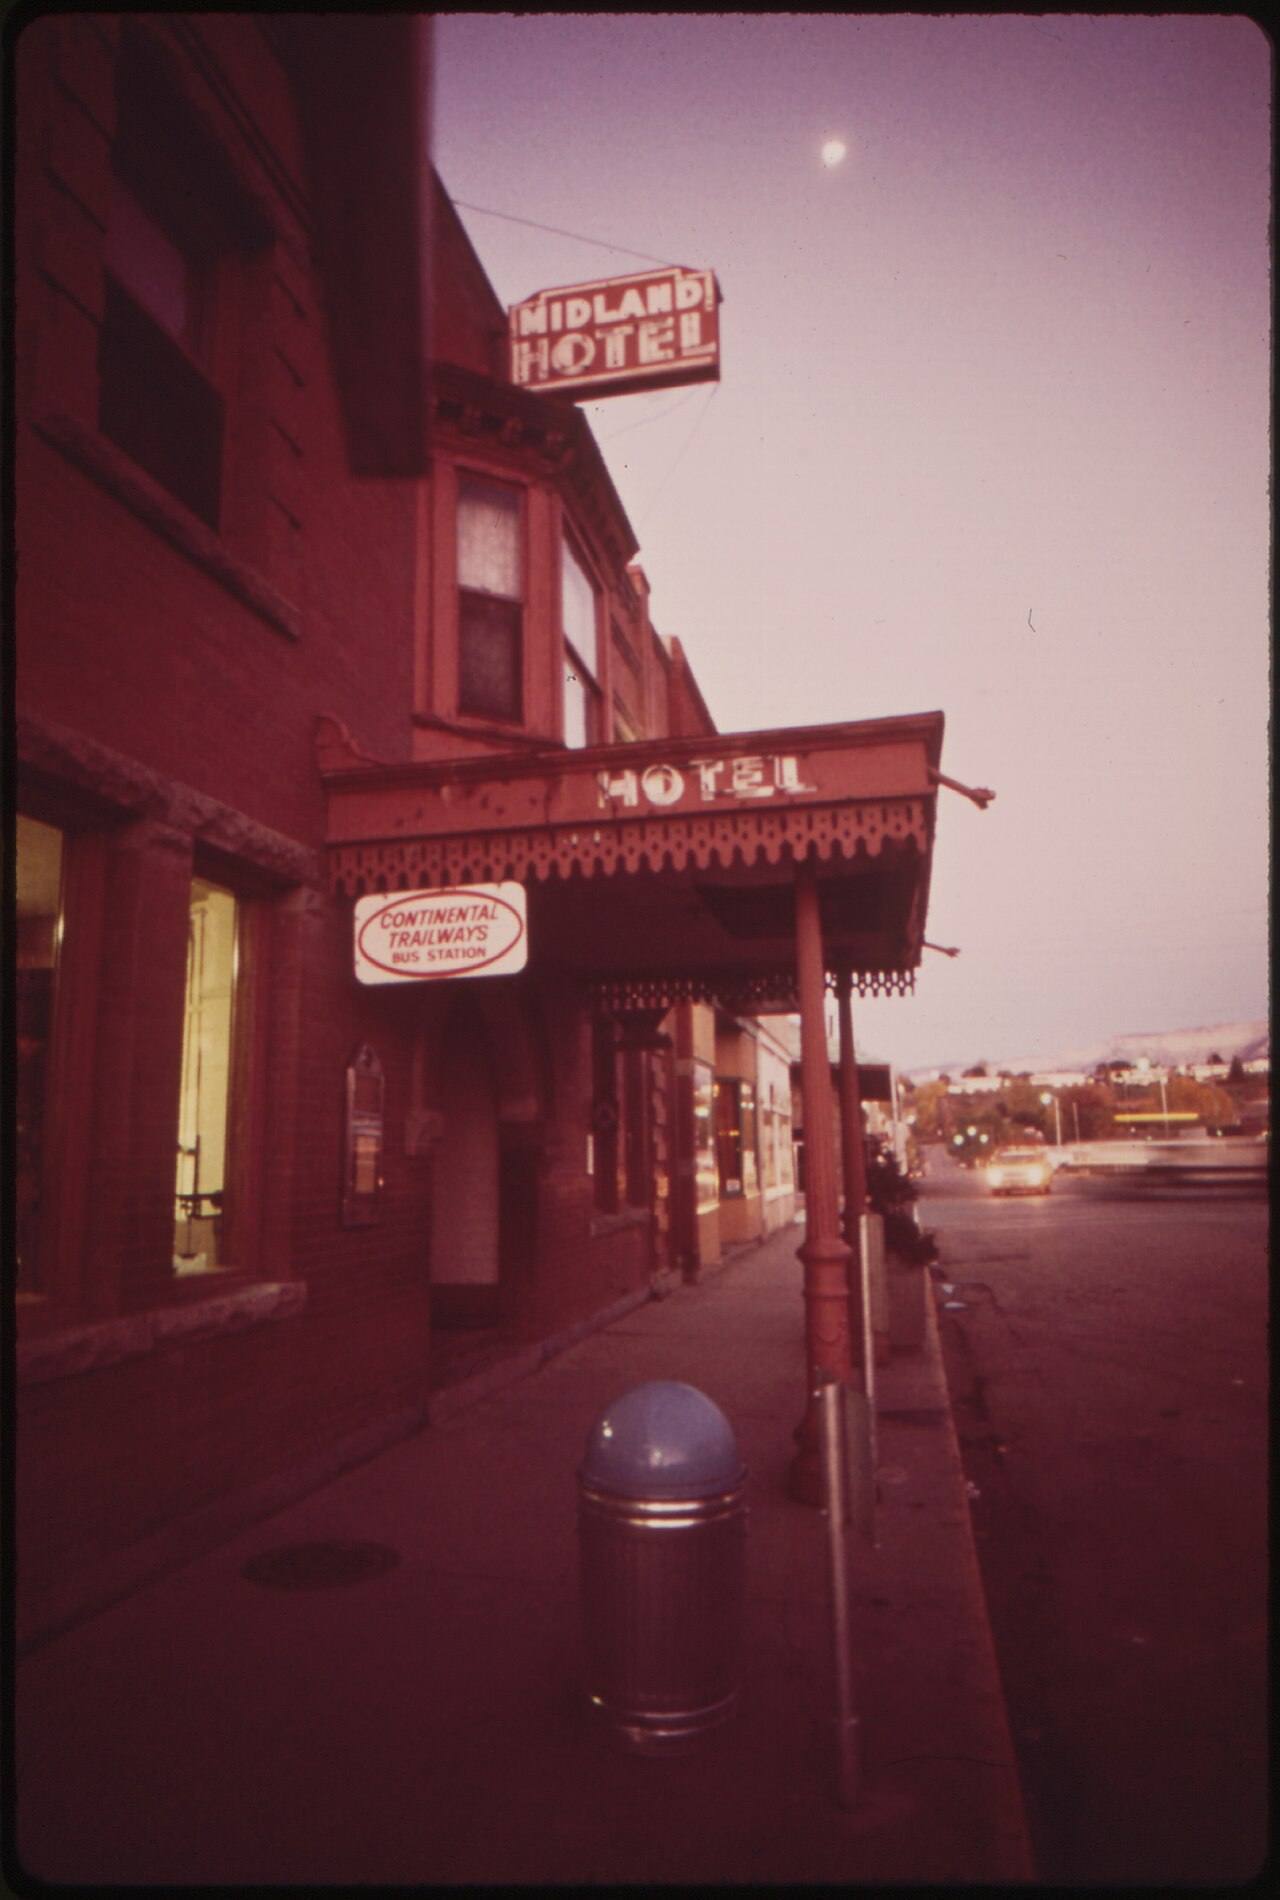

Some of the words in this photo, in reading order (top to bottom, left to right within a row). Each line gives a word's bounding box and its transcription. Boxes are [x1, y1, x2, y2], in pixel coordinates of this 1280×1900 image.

[519, 278, 704, 336] MIDLAND
[512, 311, 718, 385] HOTEL
[597, 755, 818, 808] HOTEL
[380, 903, 499, 929] CONTINENTAL
[389, 925, 489, 949] TRAILWAYS
[392, 951, 420, 964] BUS
[427, 948, 486, 962] STATION
